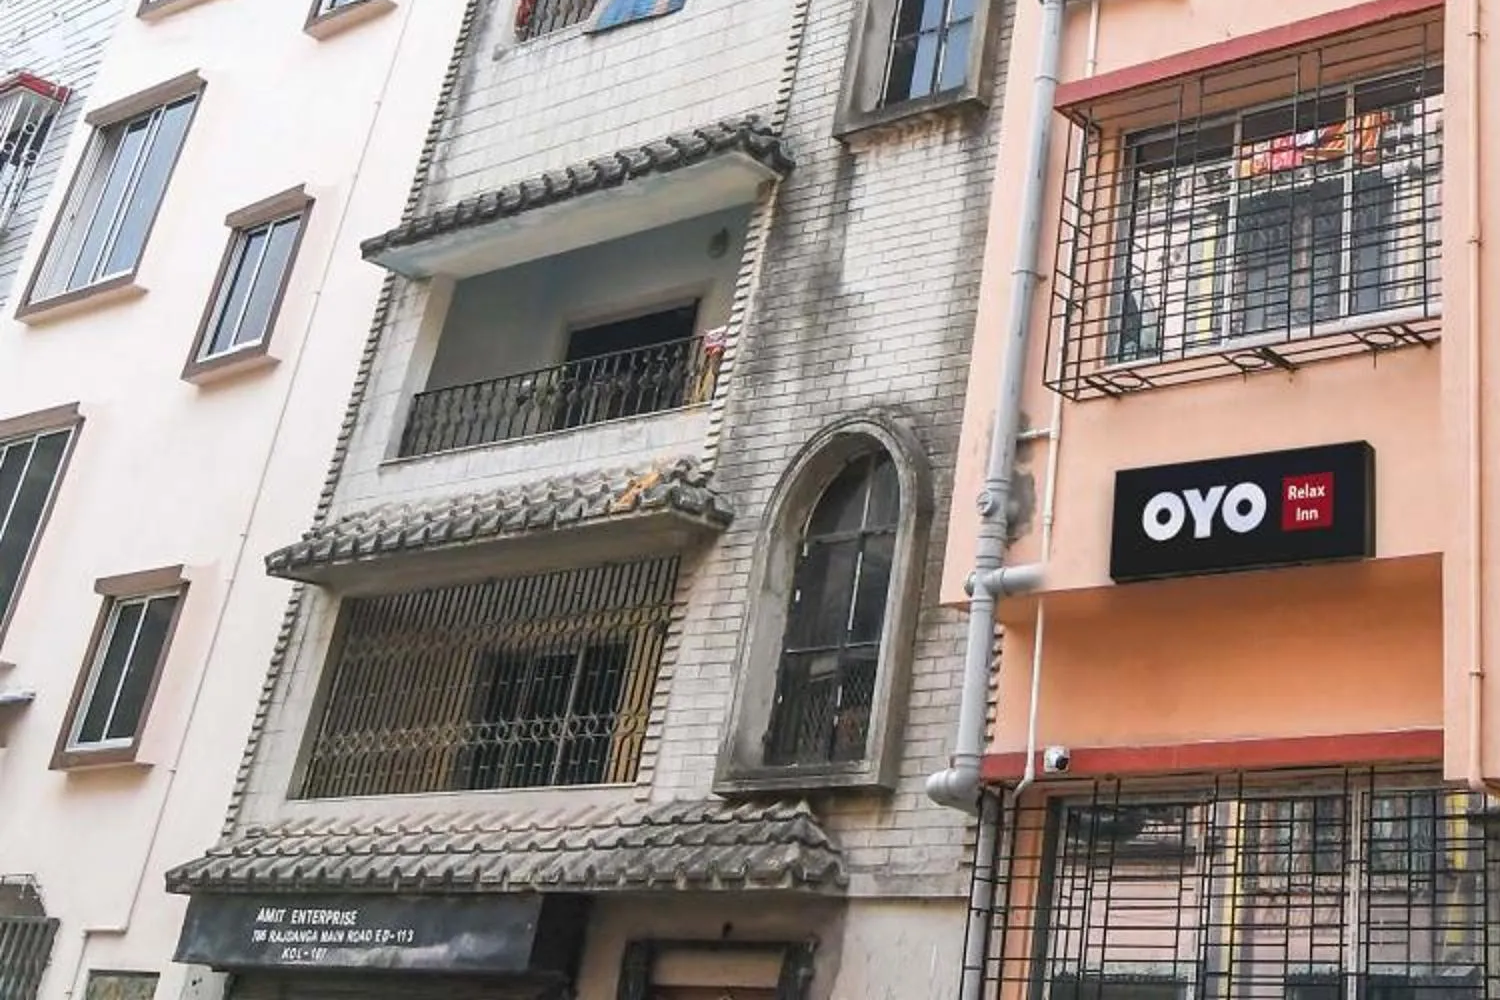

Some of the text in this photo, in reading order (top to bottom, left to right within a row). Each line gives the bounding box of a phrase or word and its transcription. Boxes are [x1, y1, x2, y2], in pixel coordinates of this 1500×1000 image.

[1288, 483, 1326, 500] Relax
[1142, 482, 1267, 541] OYO
[1296, 507, 1319, 521] Inn
[256, 907, 359, 925] AMIT ENTERPRISE
[320, 930, 345, 943] MAIN
[347, 930, 373, 943] ROAD
